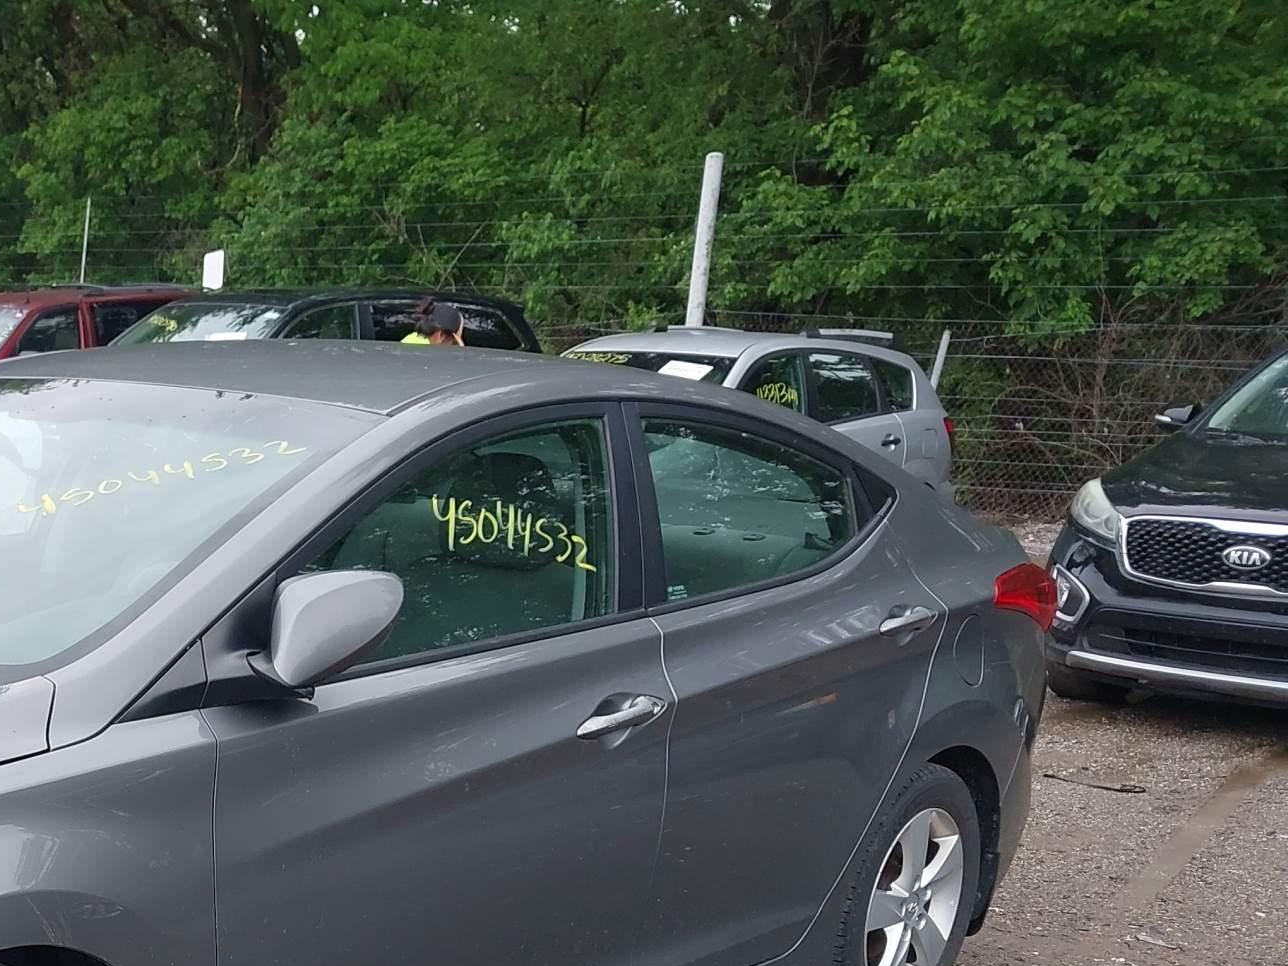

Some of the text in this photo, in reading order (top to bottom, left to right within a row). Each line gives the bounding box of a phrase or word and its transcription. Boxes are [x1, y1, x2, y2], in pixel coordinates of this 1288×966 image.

[18, 440, 308, 517] 45044532
[432, 494, 597, 572] 45044532
[1229, 550, 1261, 566] KIA
